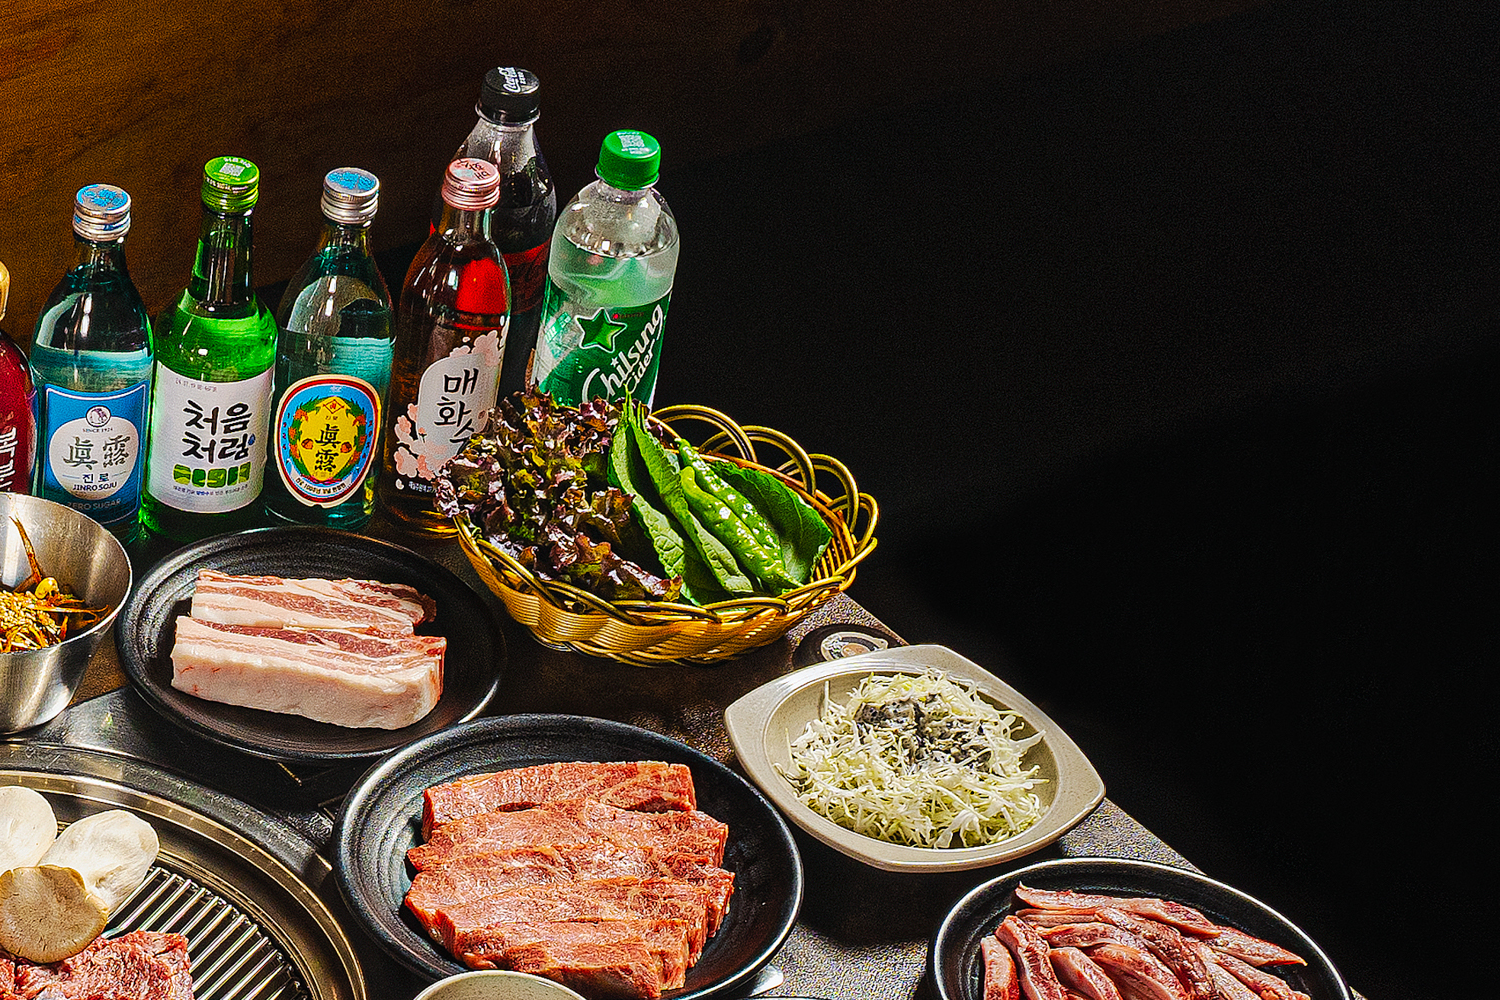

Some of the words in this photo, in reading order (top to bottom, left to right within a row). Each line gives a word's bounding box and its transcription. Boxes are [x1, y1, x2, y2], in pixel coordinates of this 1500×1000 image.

[182, 399, 253, 436] 처음
[182, 431, 250, 464] 처럼
[72, 484, 98, 492] JINRO
[98, 481, 118, 491] SOJU
[93, 497, 120, 509] SUGAR
